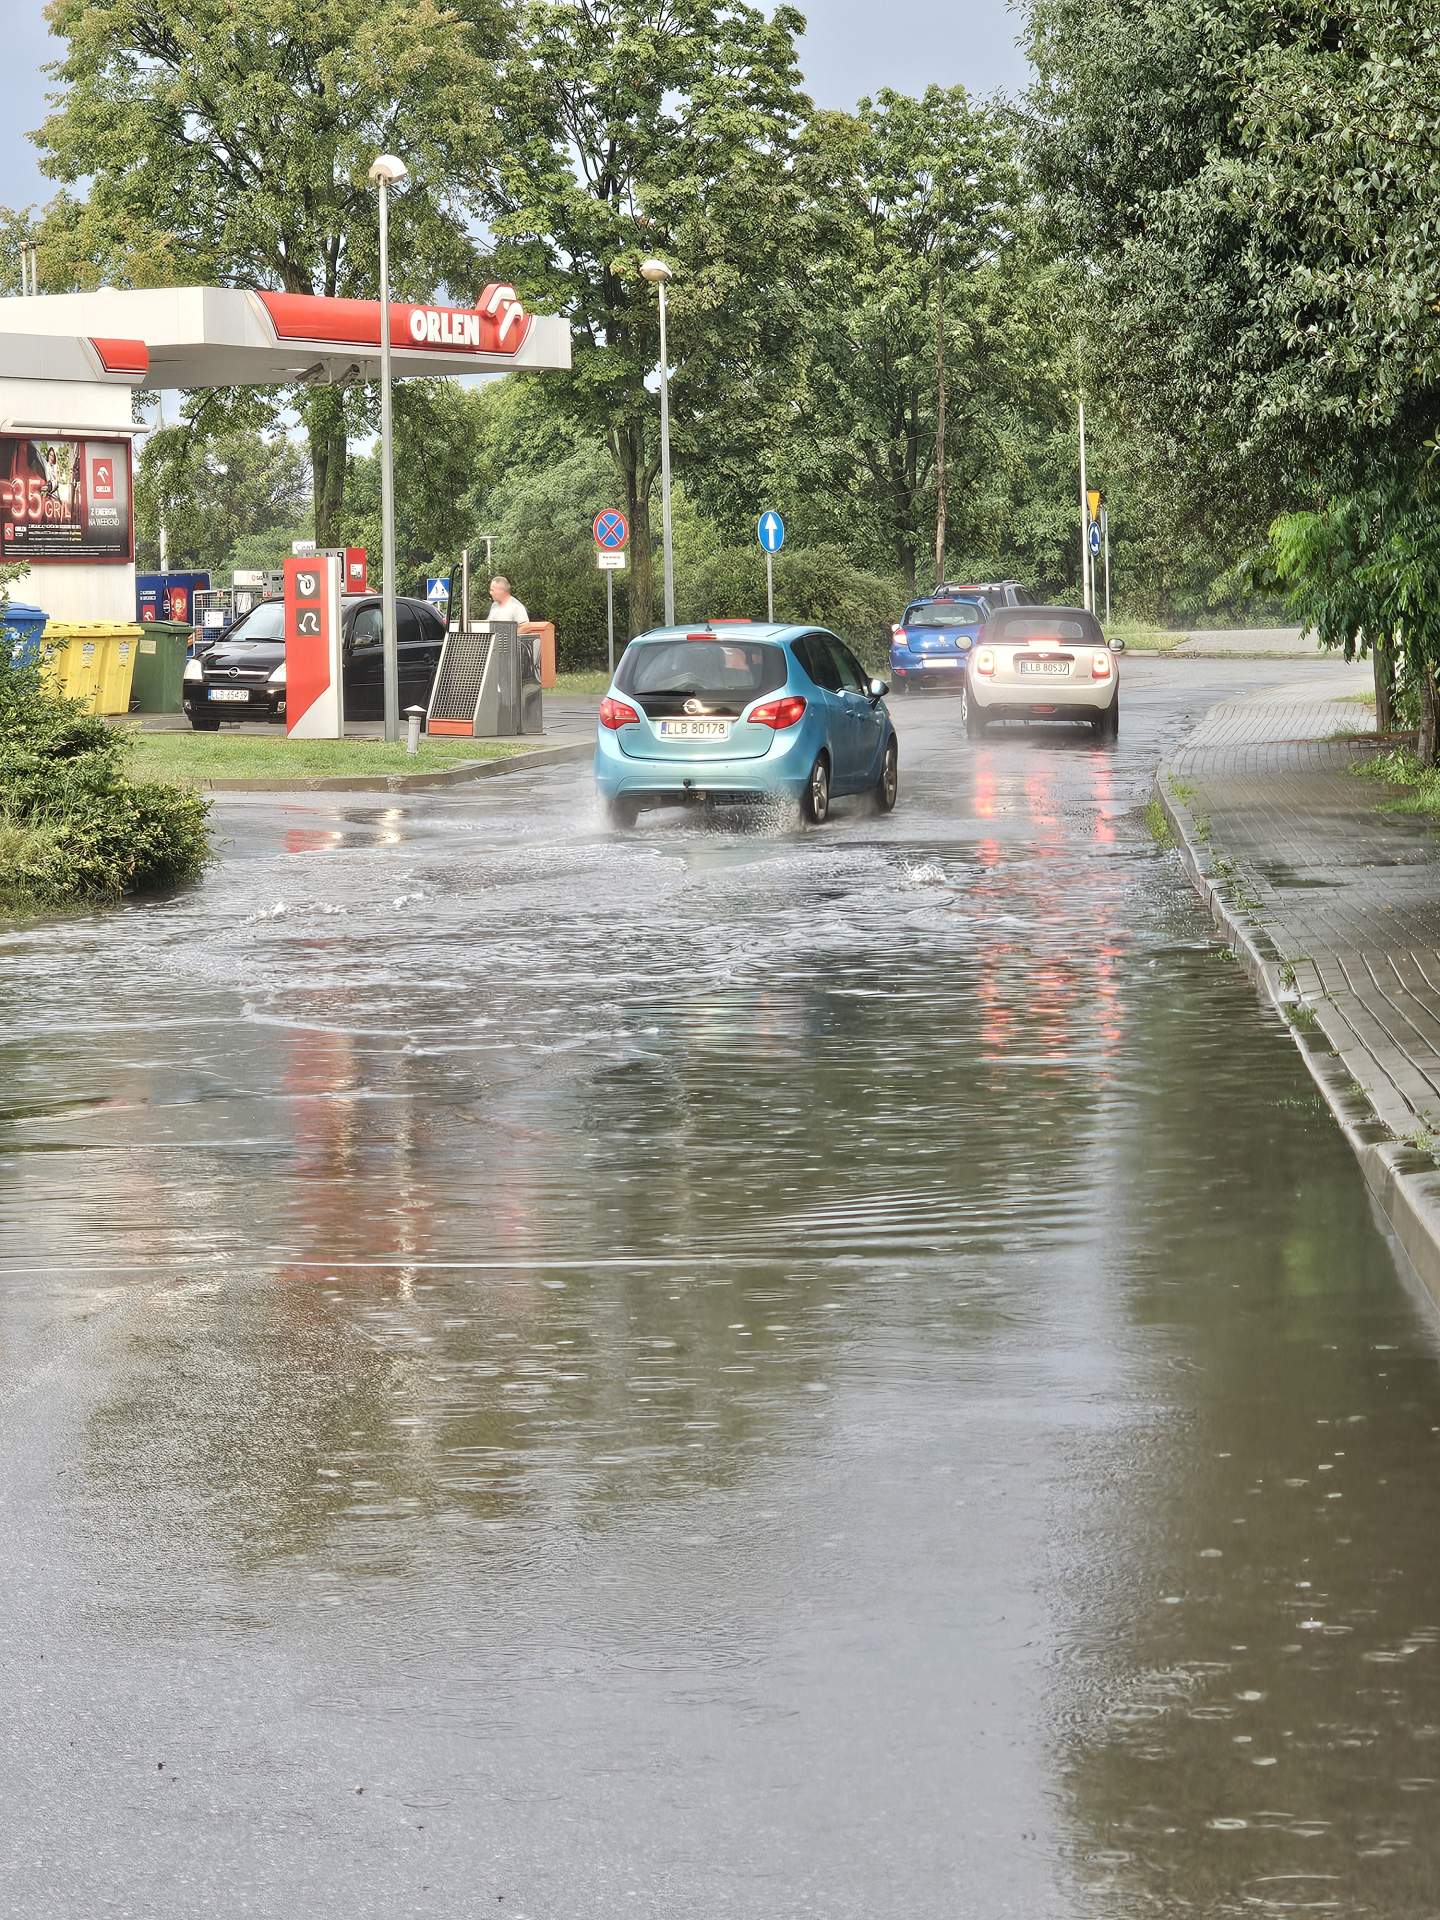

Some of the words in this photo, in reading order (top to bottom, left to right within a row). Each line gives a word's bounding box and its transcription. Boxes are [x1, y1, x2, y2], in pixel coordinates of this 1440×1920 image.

[410, 309, 480, 345] ORLEN
[2, 478, 42, 518] -35
[668, 723, 688, 734] LLB
[691, 723, 726, 734] 80178
